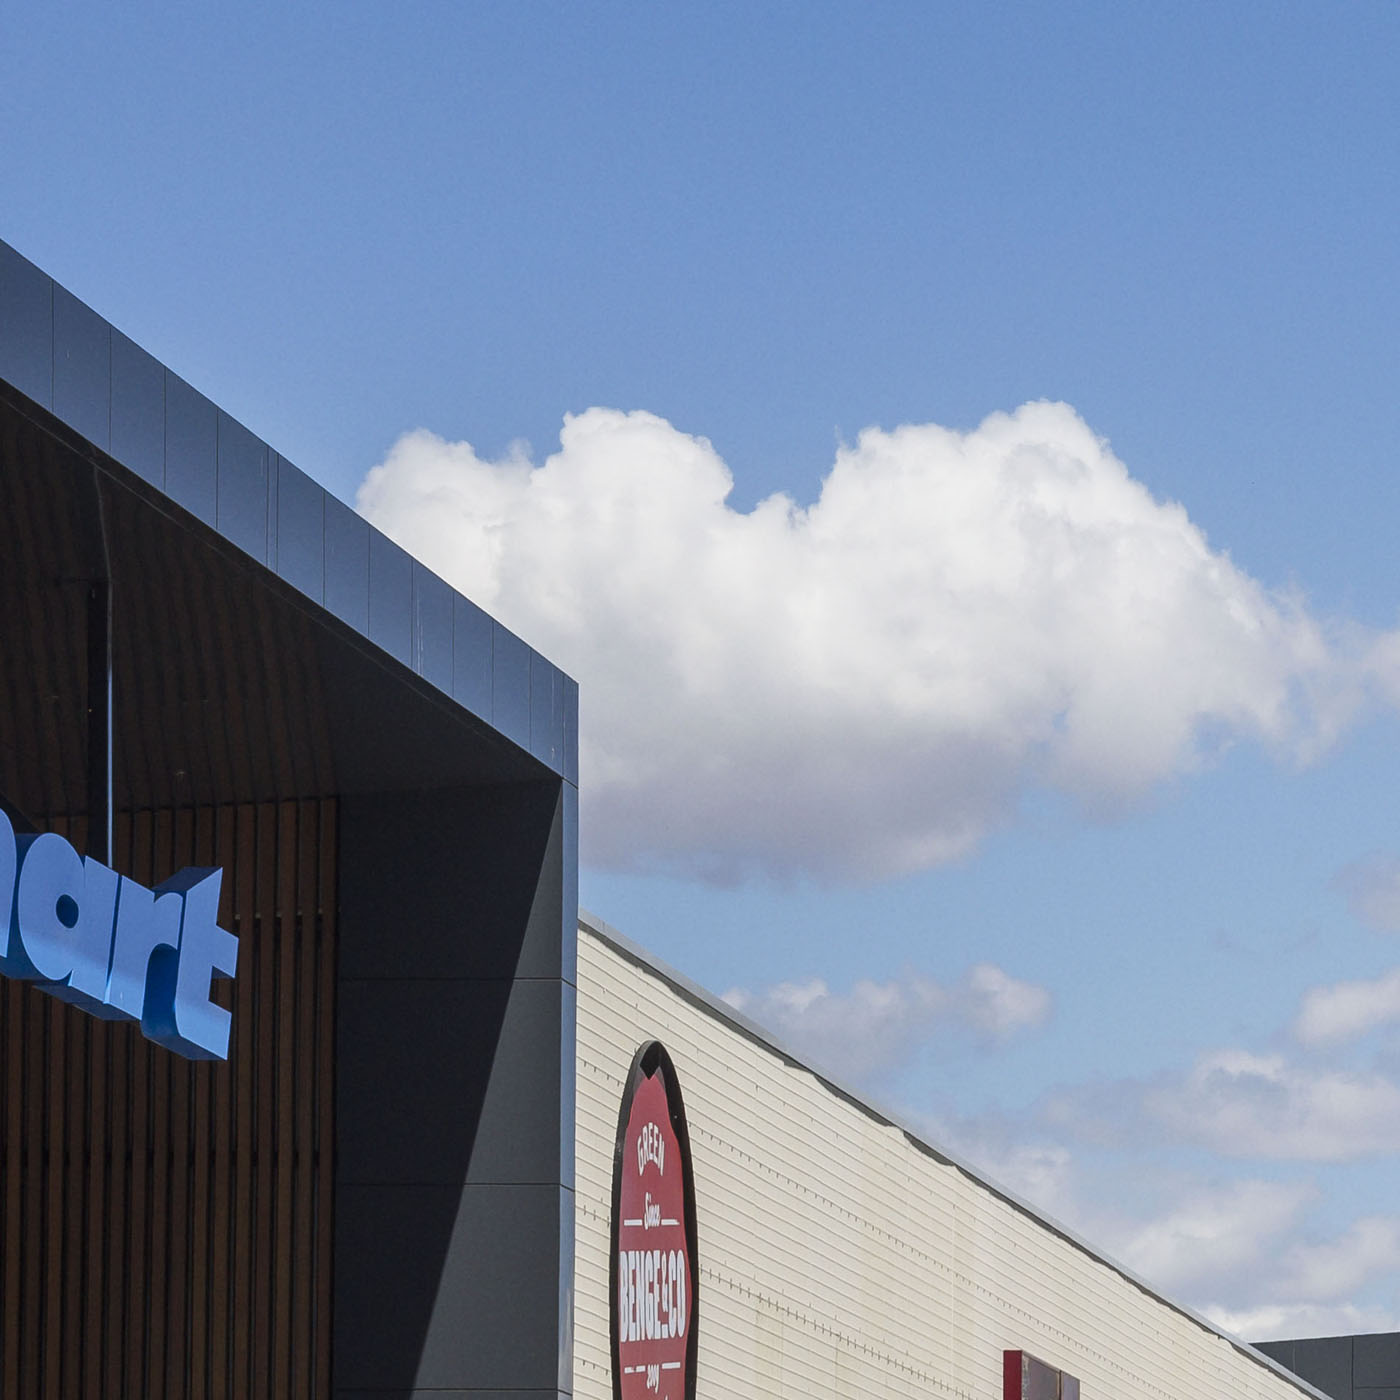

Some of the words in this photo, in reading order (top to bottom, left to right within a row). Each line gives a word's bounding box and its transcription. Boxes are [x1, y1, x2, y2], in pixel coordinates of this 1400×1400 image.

[0, 808, 239, 1061] art
[637, 1122, 665, 1176] GREEN
[644, 1191, 661, 1230] Since
